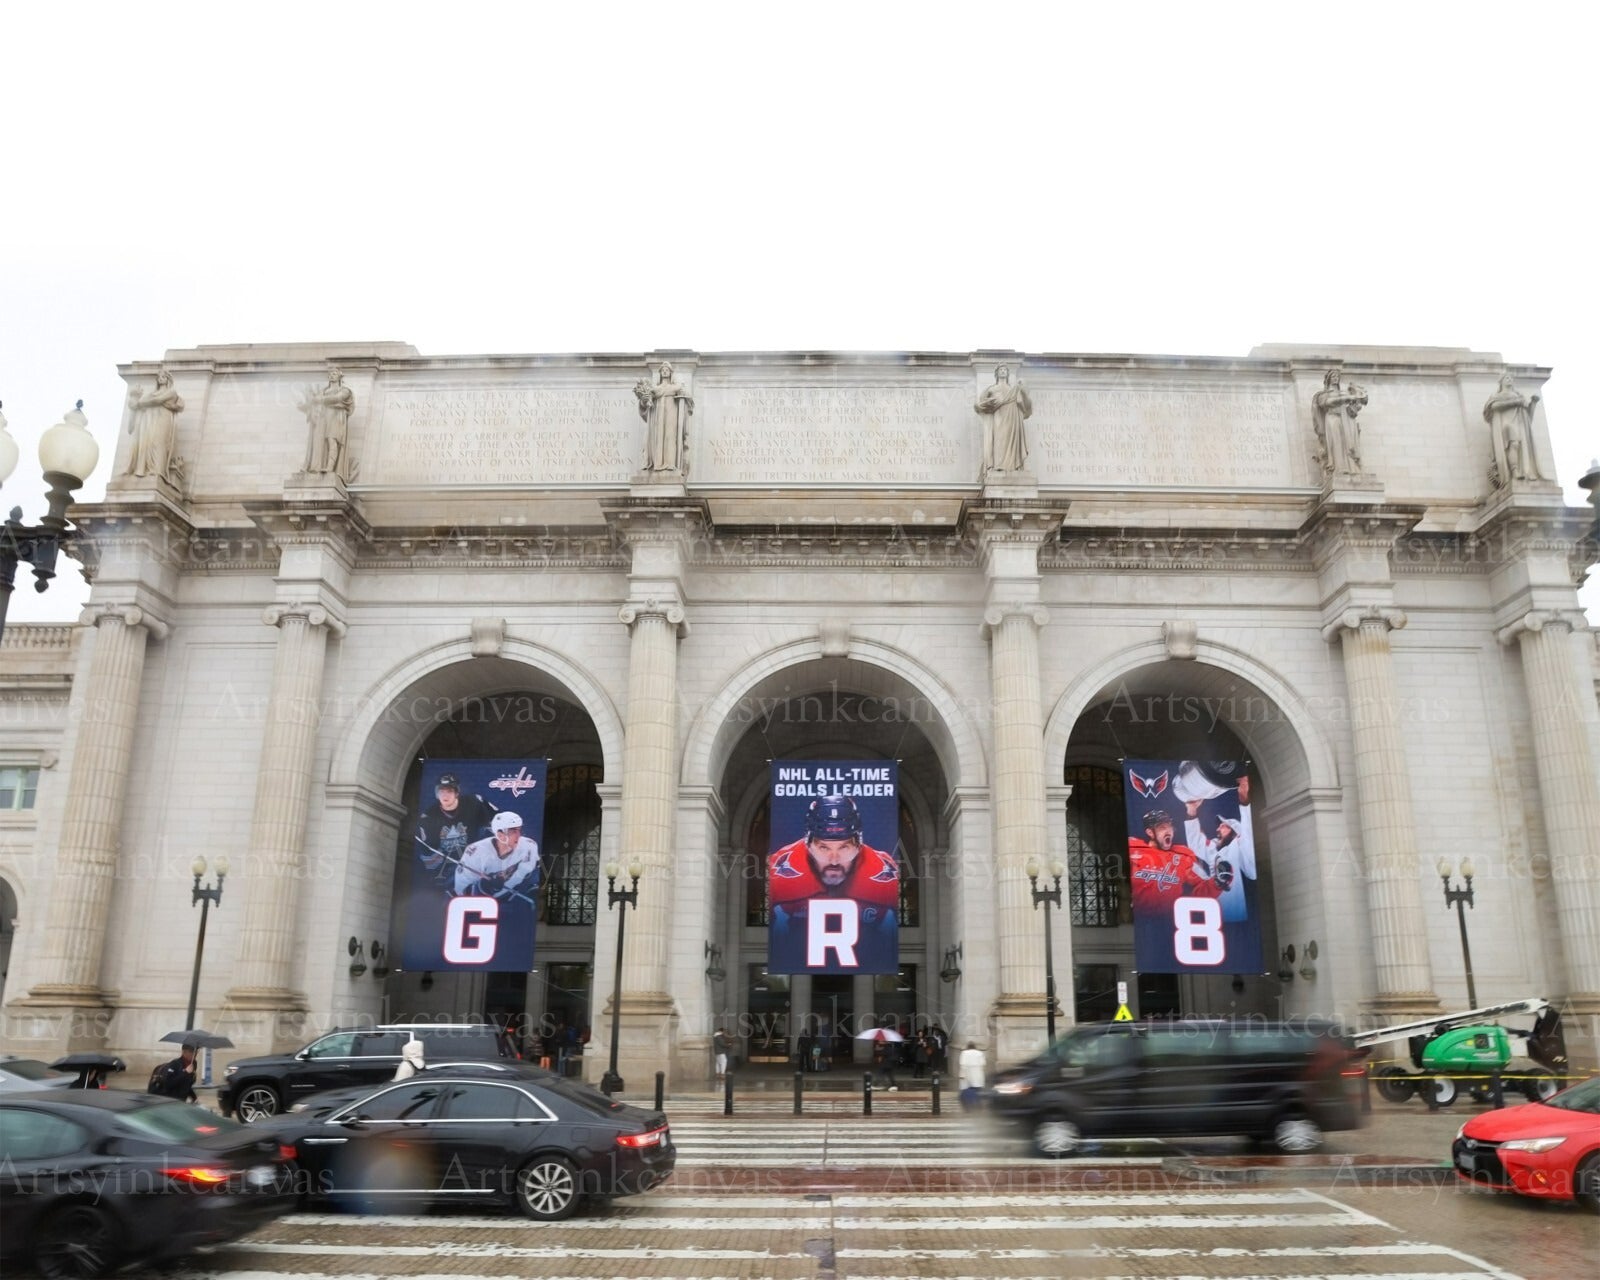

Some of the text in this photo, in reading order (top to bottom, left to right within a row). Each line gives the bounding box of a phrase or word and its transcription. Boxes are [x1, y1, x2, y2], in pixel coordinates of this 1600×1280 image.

[774, 784, 894, 797] GOALS LEADER
[779, 768, 890, 780] NHL ALL-TIME
[443, 896, 499, 964] G
[806, 898, 859, 967] R
[1173, 896, 1225, 965] 8
